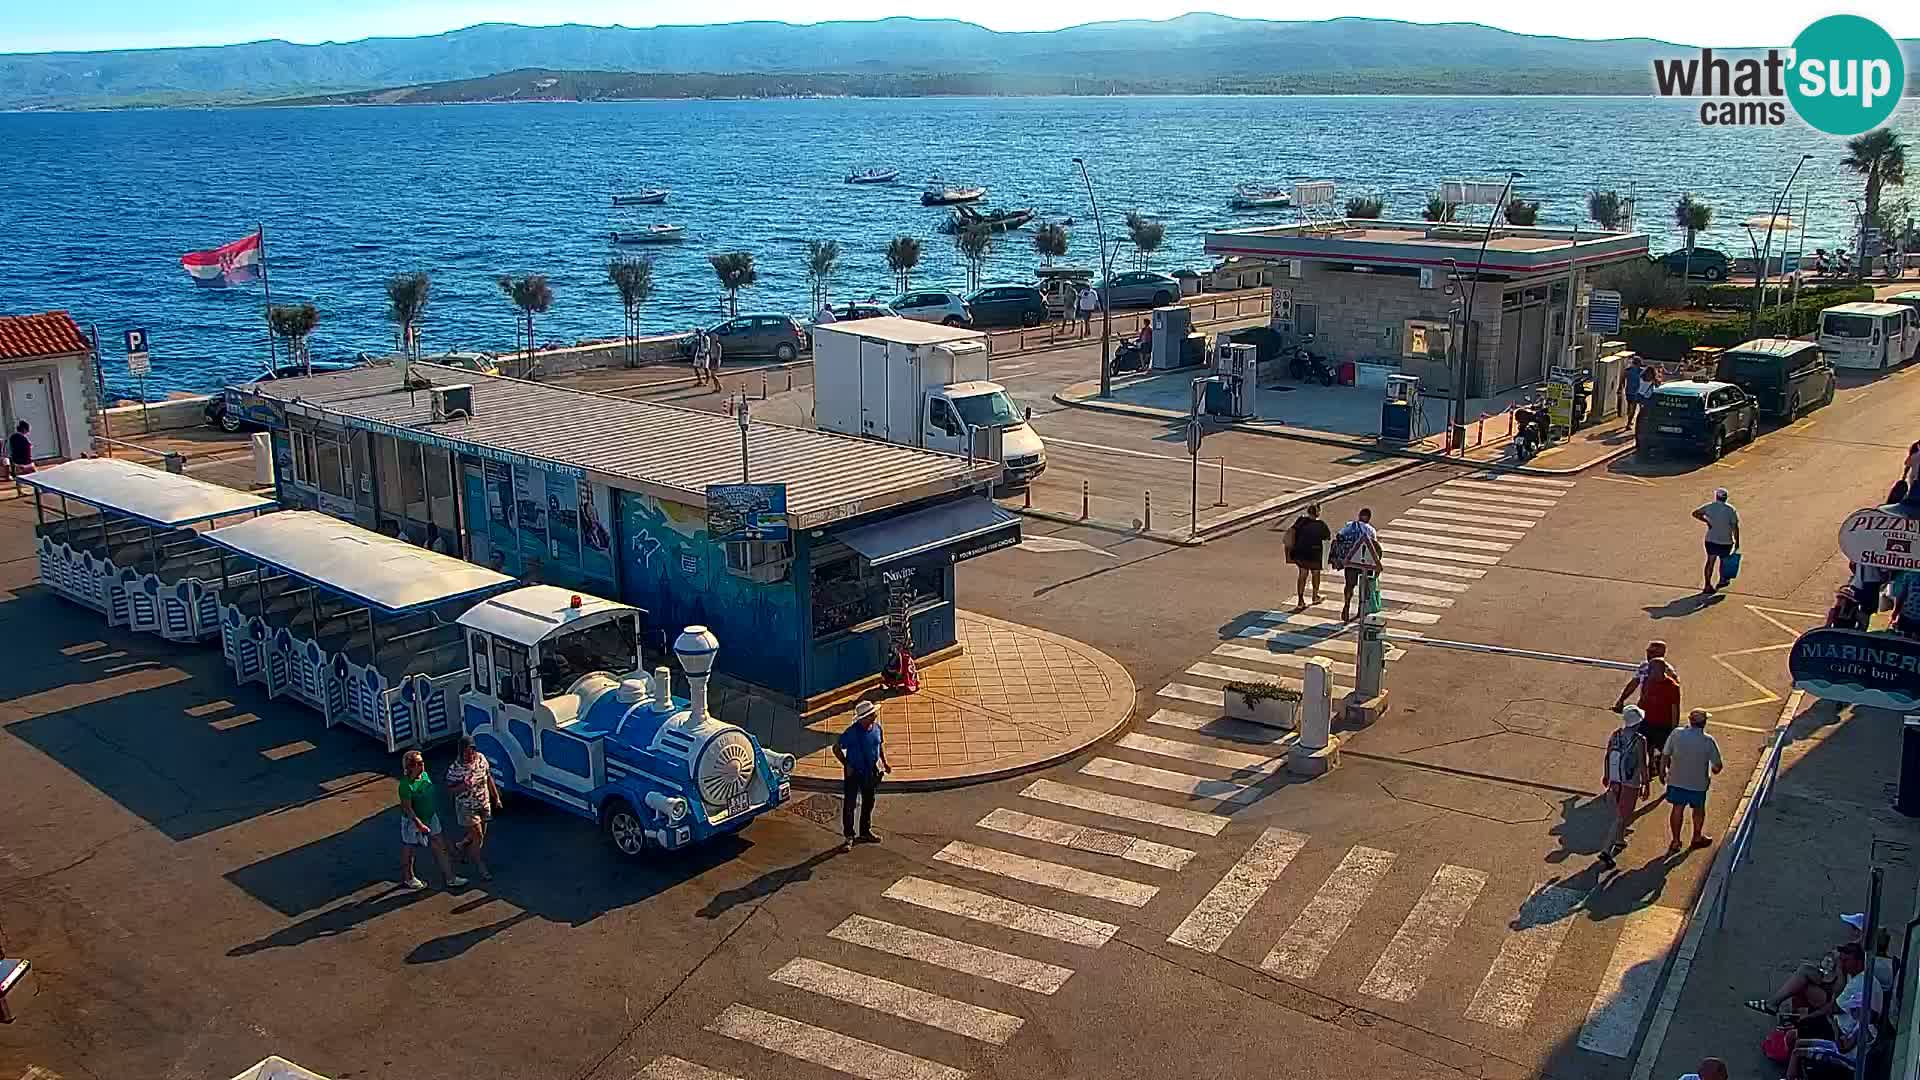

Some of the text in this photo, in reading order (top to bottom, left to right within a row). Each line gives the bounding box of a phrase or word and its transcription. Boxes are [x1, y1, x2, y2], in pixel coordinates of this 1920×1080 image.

[130, 332, 141, 350] P
[478, 446, 492, 457] BUS
[495, 450, 526, 464] STATION
[529, 458, 553, 472] TICKET
[555, 463, 582, 477] OFFICE
[1871, 666, 1899, 680] bar
